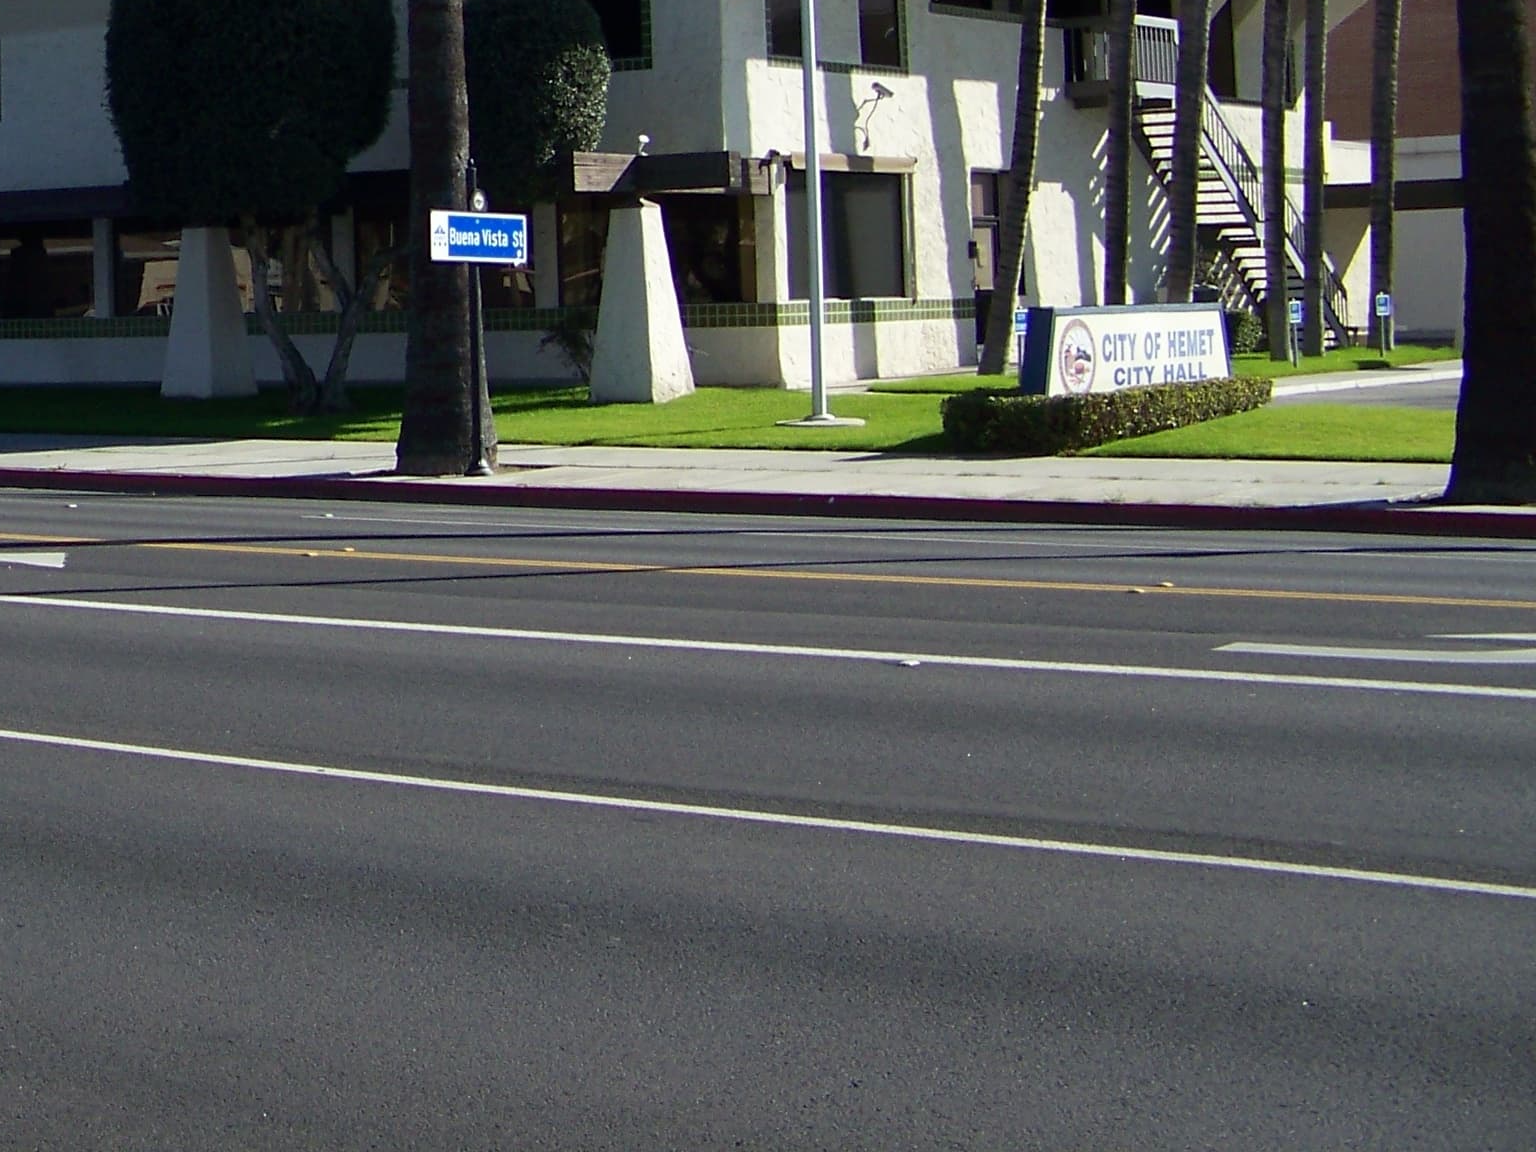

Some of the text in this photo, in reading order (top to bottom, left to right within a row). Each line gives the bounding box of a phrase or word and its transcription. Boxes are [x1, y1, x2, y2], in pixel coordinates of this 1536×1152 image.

[449, 227, 524, 248] Buena Vista St
[1102, 329, 1214, 362] CITY OF HEMET
[1114, 362, 1207, 386] CITY HALL
